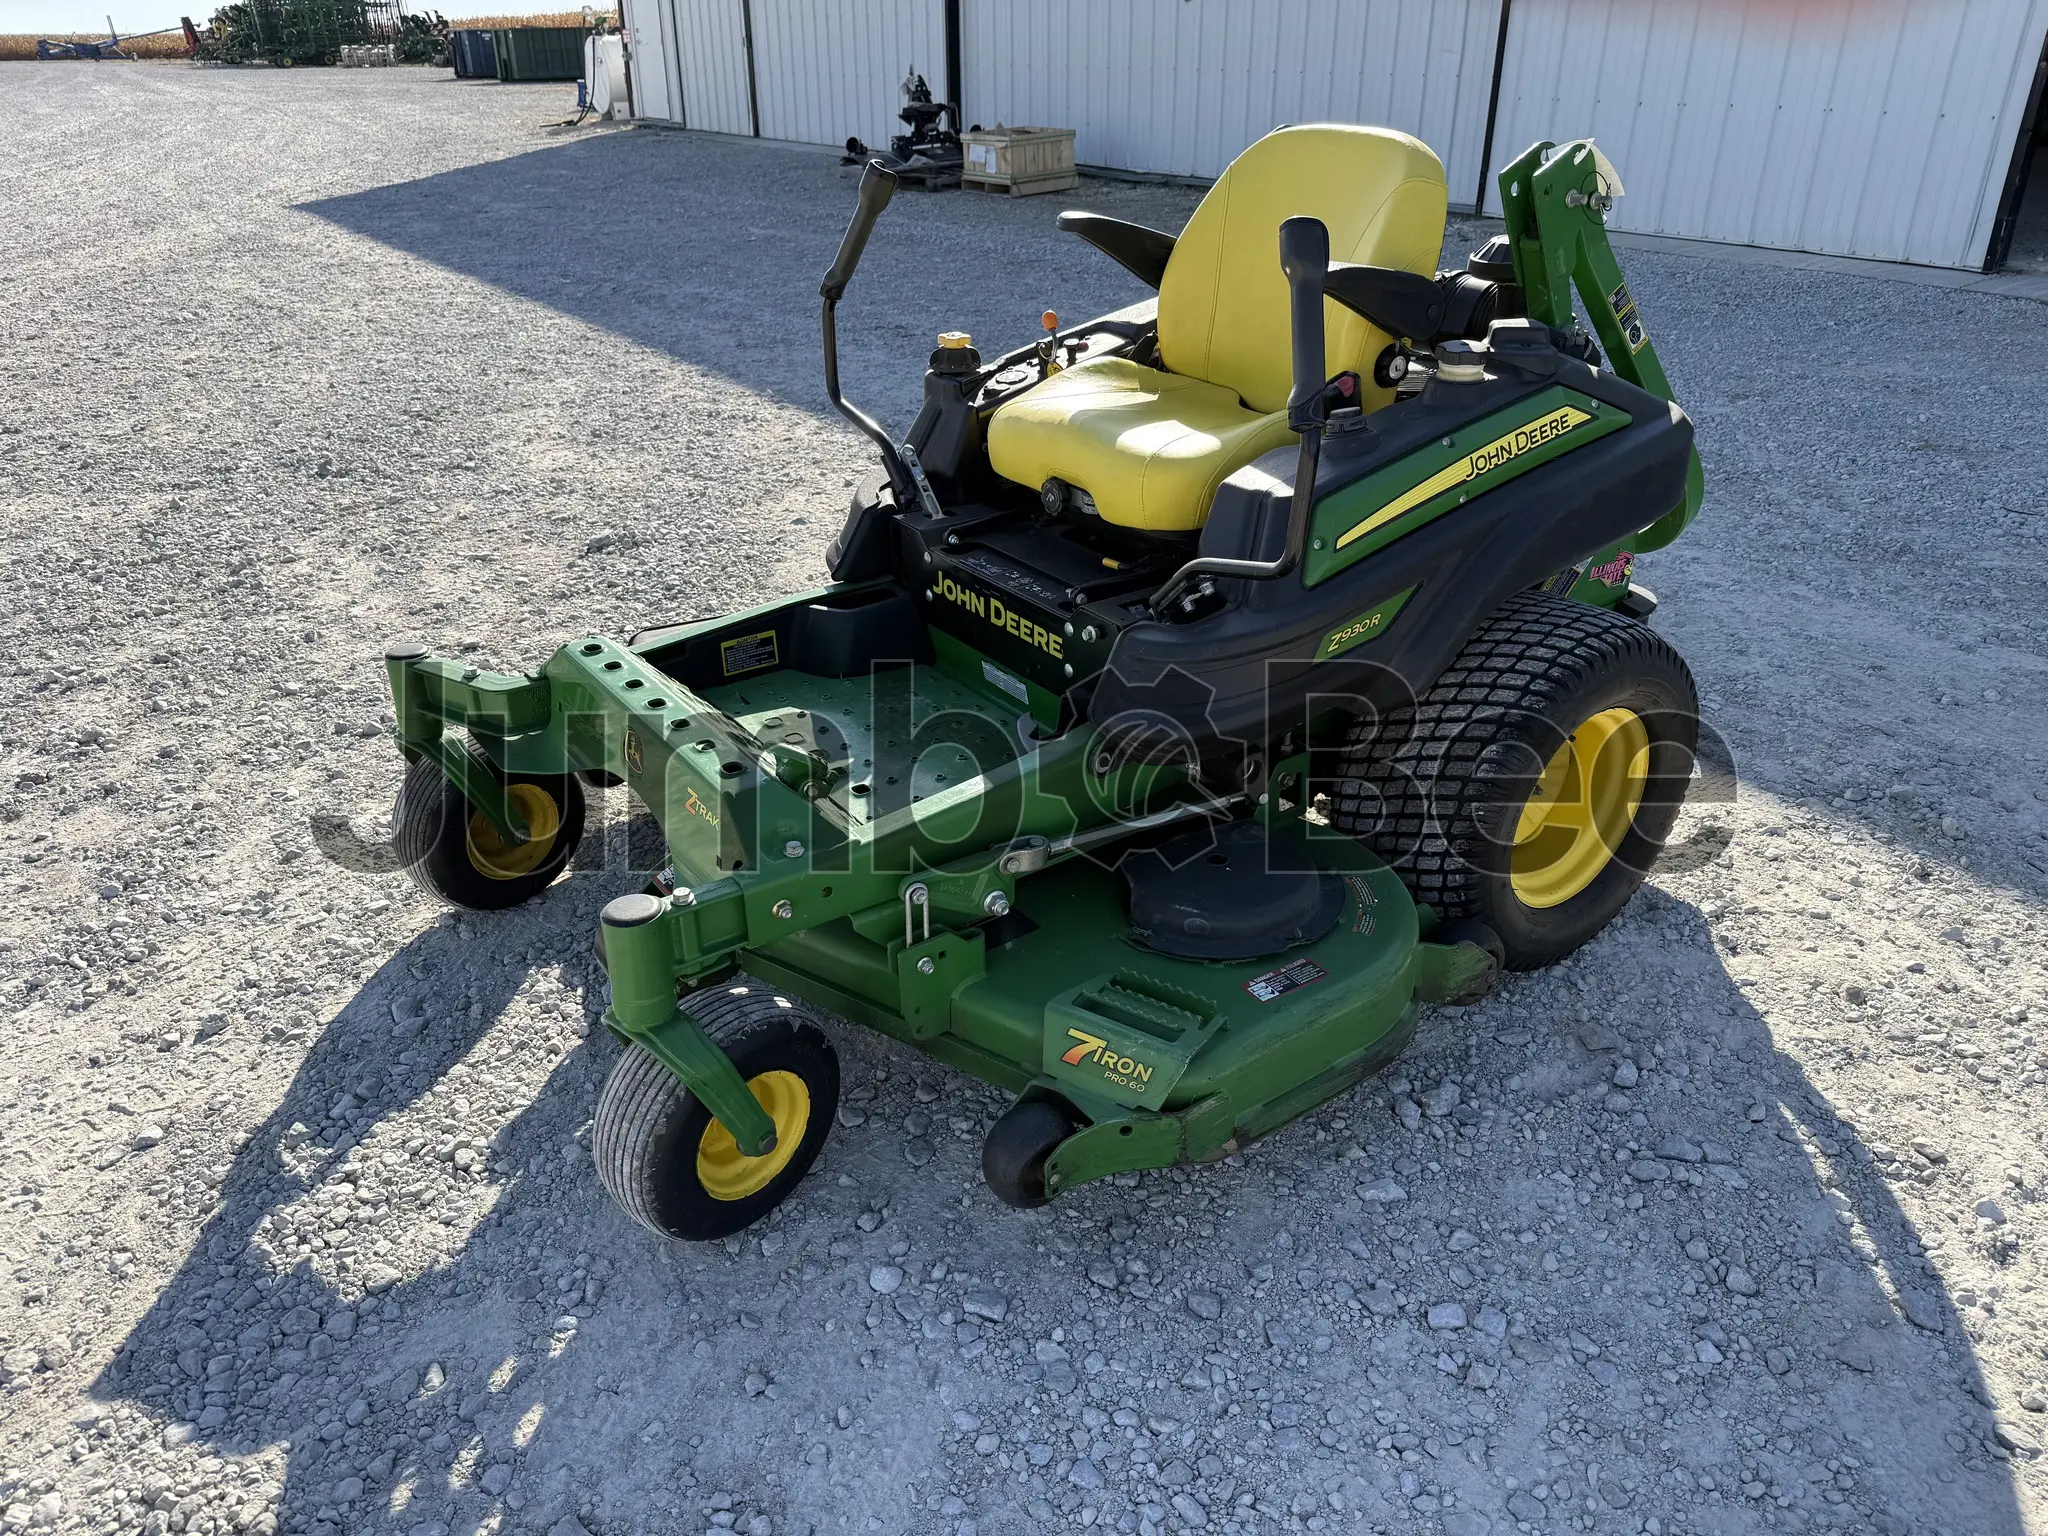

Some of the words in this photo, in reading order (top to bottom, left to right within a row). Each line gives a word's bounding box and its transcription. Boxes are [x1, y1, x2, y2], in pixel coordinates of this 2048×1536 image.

[1465, 441, 1512, 479] JOHN
[1514, 413, 1570, 453] DEERE
[1590, 558, 1627, 579] ILLINOIS
[933, 570, 985, 618] JOHN
[990, 597, 1063, 660] DEERE
[1326, 613, 1382, 653] Z930R
[1254, 971, 1275, 983] DANGER
[1103, 1070, 1128, 1085] PRO
[1128, 1081, 1146, 1093] 60
